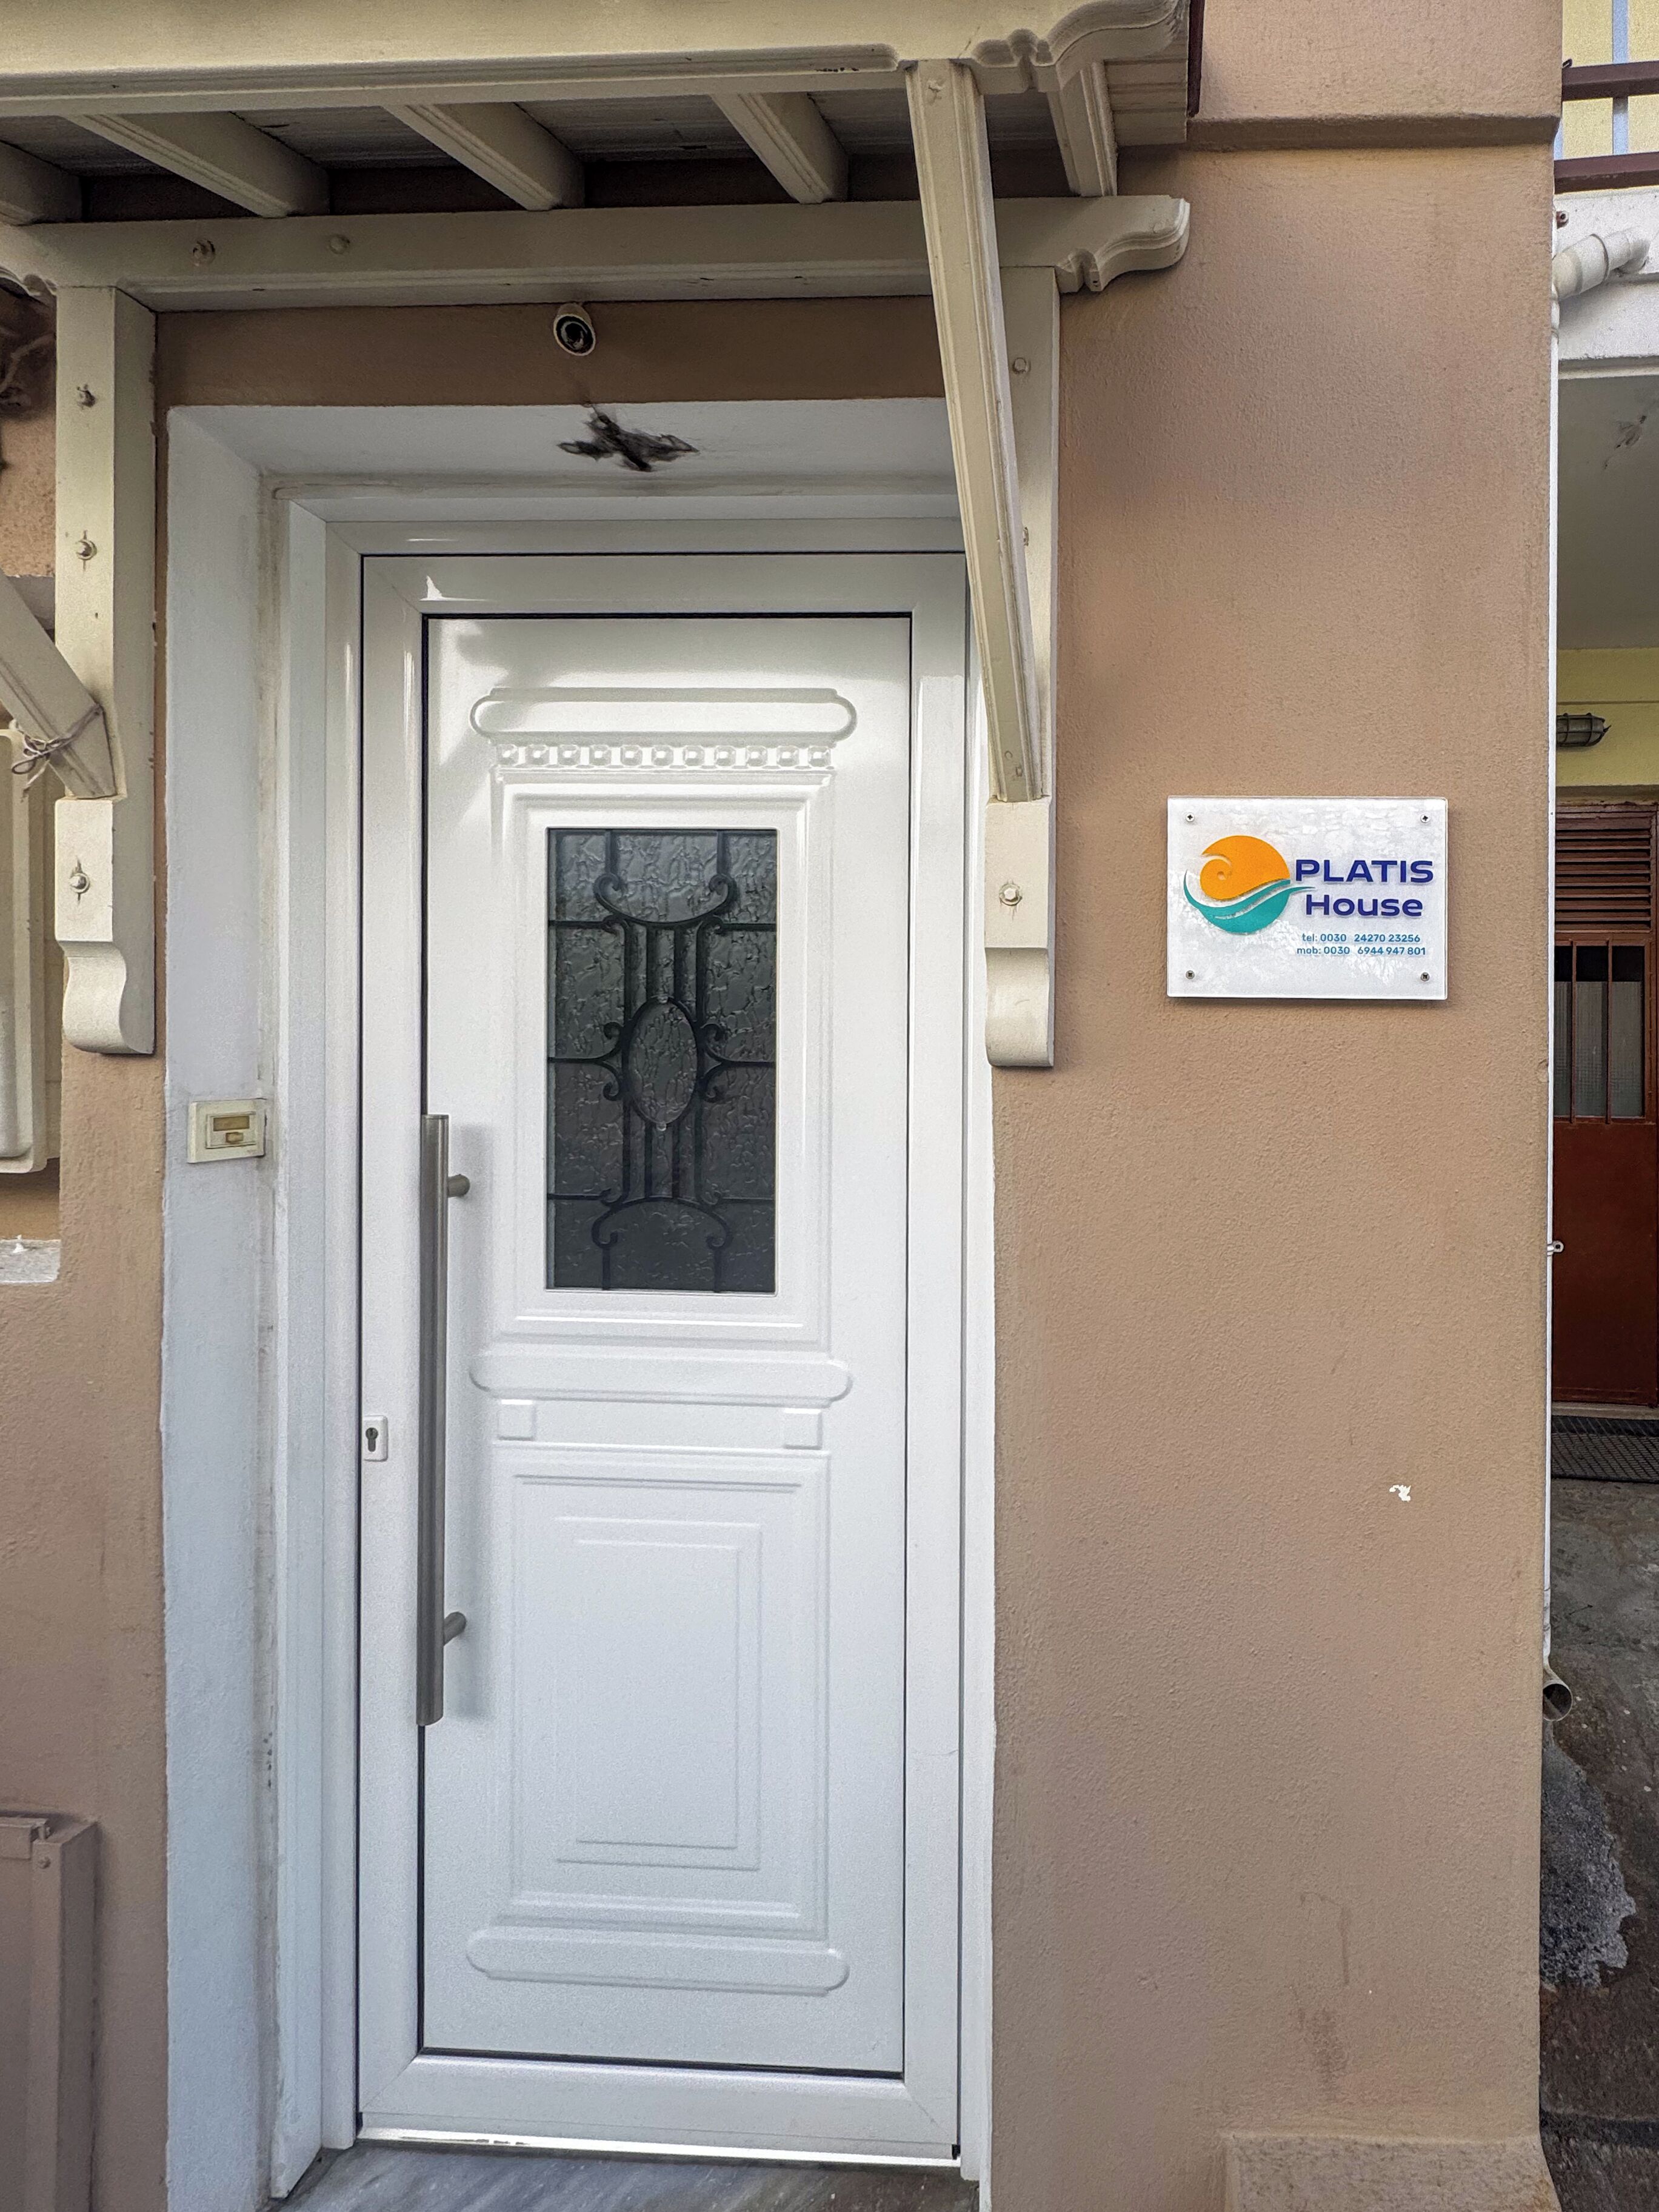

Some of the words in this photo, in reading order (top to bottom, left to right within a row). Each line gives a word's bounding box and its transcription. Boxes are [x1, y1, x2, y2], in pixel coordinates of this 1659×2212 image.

[1295, 859, 1434, 883] PLATIS
[1306, 894, 1423, 917] House
[1301, 933, 1318, 942] tel:
[1320, 934, 1347, 942] 0030
[1354, 934, 1386, 942] 24270
[1388, 934, 1421, 943] 23256
[1324, 946, 1350, 955] 0030
[1357, 946, 1384, 955] 6944
[1386, 946, 1405, 955] 947
[1407, 947, 1426, 955] 801
